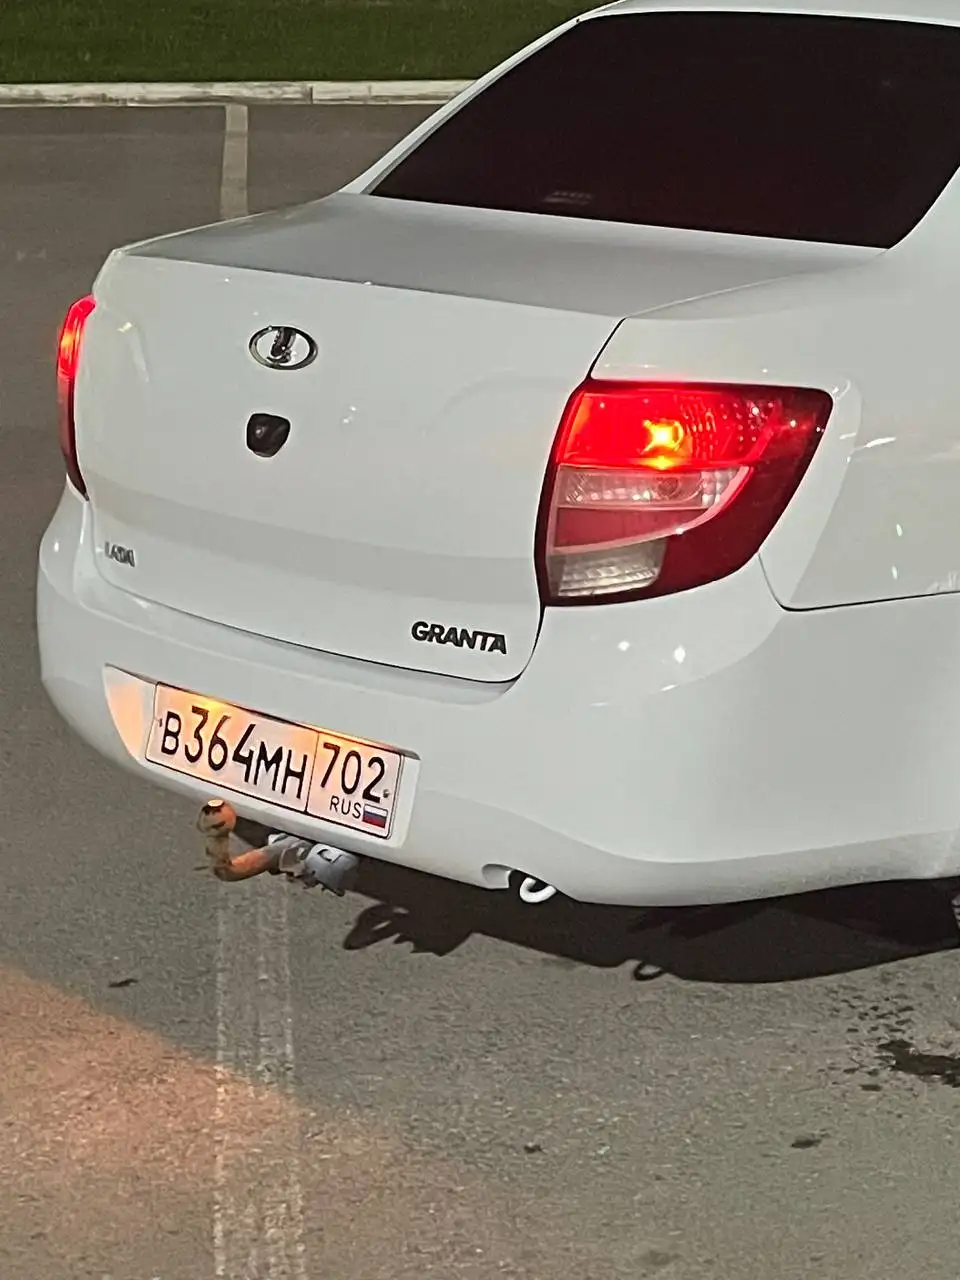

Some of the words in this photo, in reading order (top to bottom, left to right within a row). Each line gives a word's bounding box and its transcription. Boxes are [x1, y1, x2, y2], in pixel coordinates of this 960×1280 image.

[411, 620, 508, 655] GRANTA
[320, 741, 388, 805] 702
[329, 794, 363, 820] RUS
